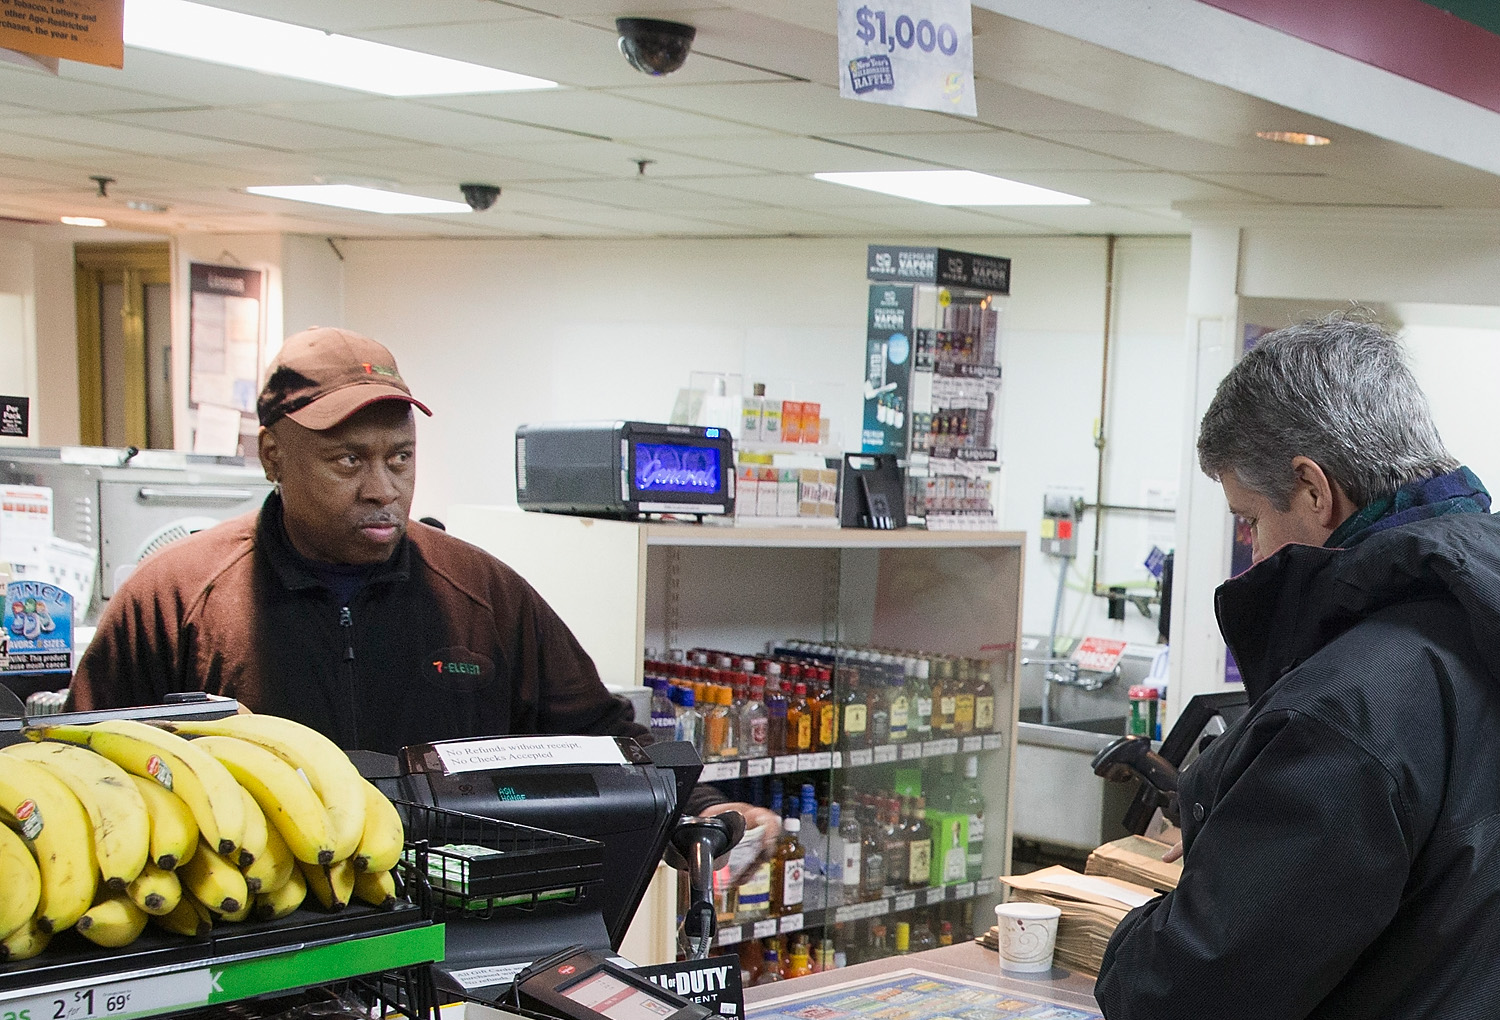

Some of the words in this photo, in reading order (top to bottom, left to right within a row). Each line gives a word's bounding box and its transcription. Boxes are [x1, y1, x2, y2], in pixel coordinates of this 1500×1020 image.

[51, 6, 79, 20] Lottery
[82, 14, 97, 22] and
[35, 26, 48, 35] the
[50, 30, 68, 40] year
[856, 5, 958, 56] $1,000
[446, 749, 463, 757] No
[466, 744, 507, 756] Refunds
[509, 742, 546, 752] without
[452, 758, 468, 766] No
[470, 754, 507, 765] Checks
[509, 752, 553, 763] Accepted
[53, 1000, 66, 1020] 2
[67, 1006, 81, 1018] for
